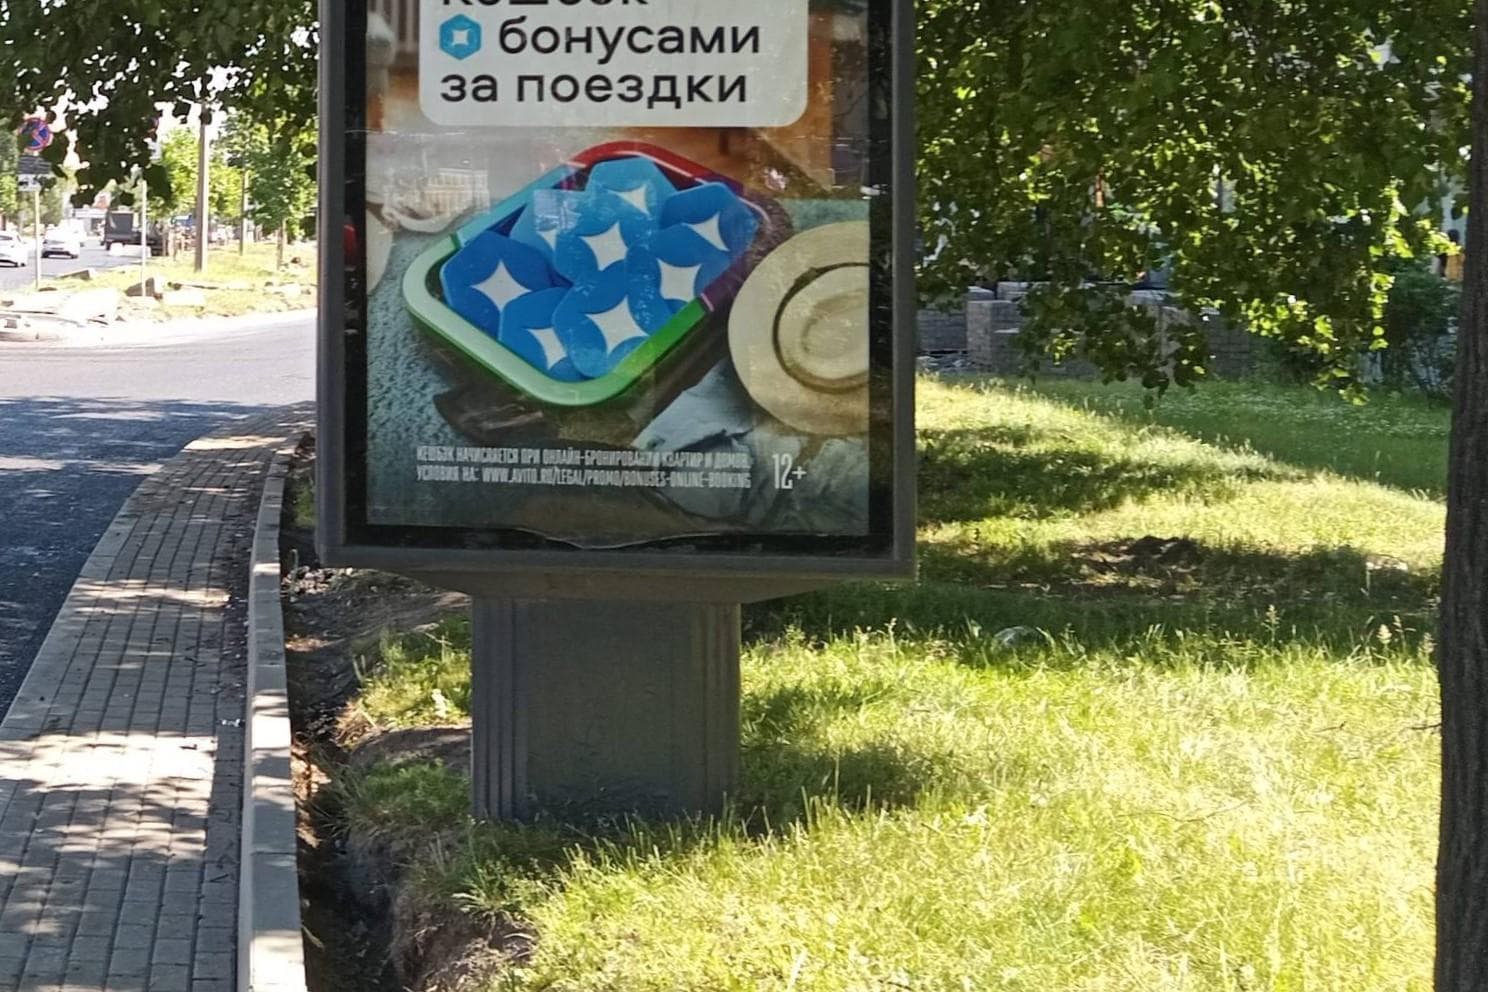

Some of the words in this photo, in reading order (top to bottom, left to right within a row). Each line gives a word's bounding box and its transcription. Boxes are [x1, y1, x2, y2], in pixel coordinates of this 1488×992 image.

[498, 15, 760, 64] бонусами
[440, 74, 498, 104] за
[517, 73, 747, 109] поездки
[772, 452, 807, 490] 12+
